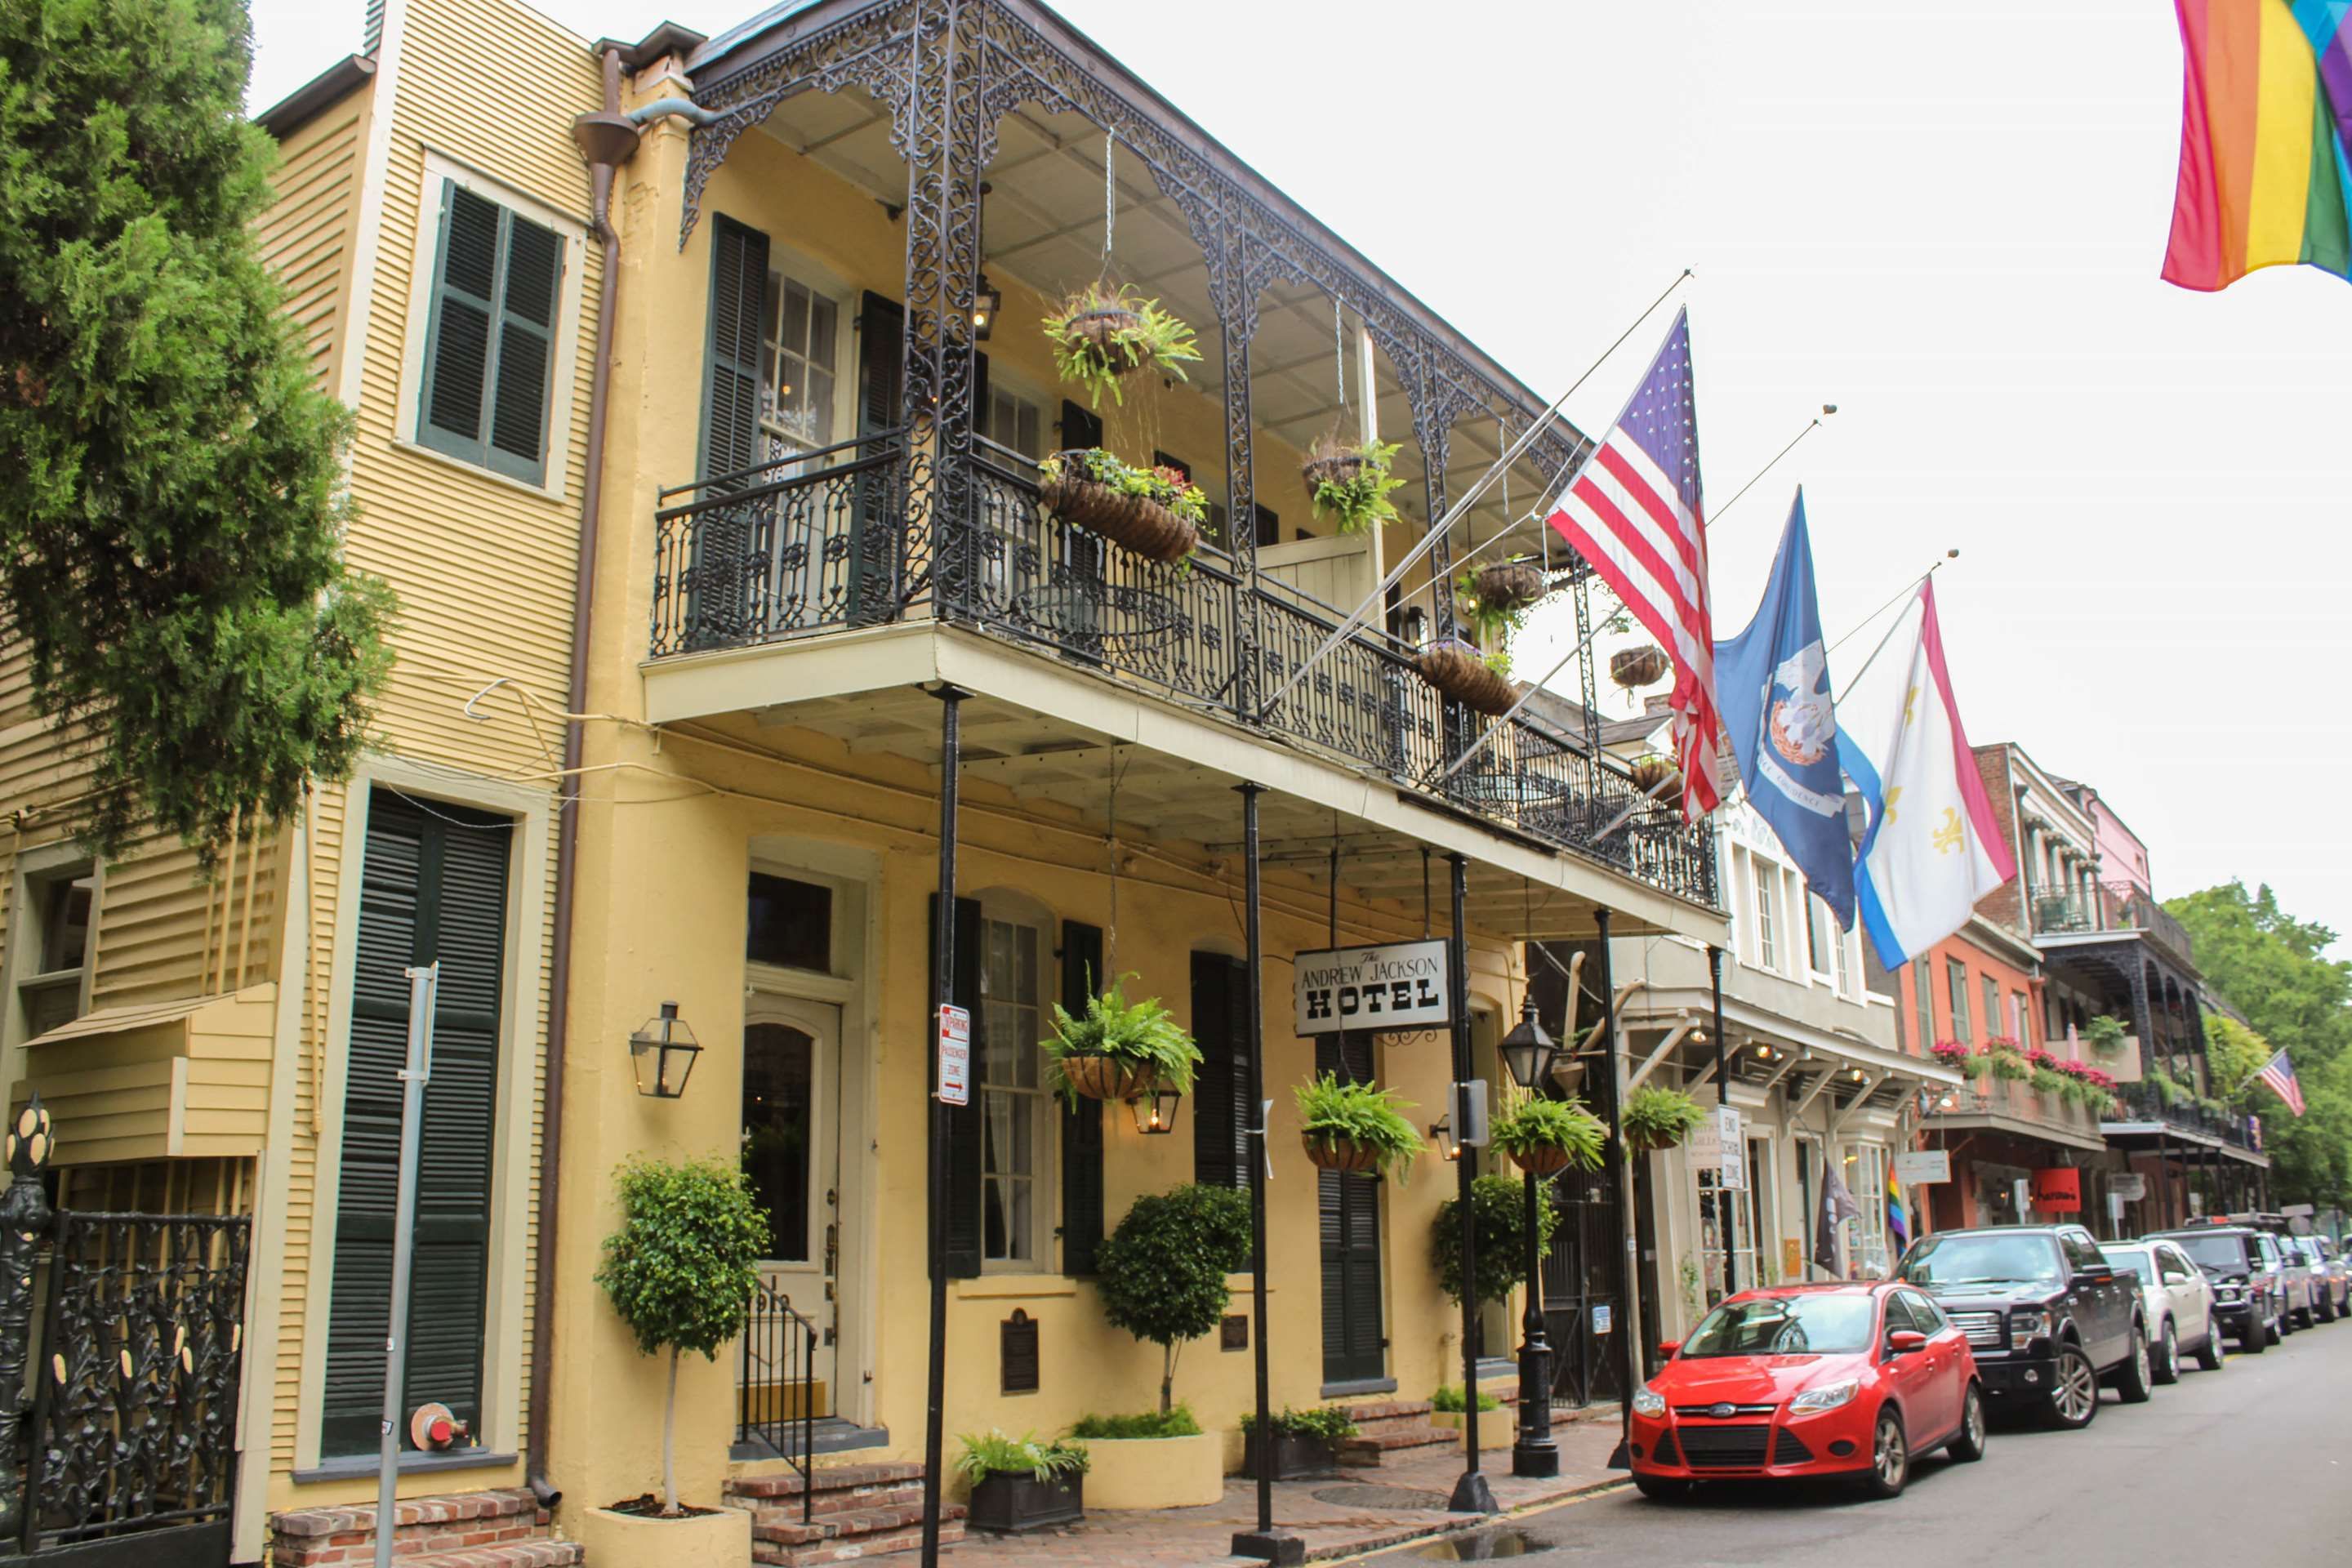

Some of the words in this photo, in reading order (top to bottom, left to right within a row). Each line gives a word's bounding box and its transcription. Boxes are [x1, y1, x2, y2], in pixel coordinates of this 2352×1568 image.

[1361, 951, 1380, 964] The
[1302, 964, 1363, 989] ANDREW
[1370, 956, 1438, 982] JACKSON
[1307, 978, 1439, 1019] HOTEL
[941, 1045, 967, 1060] PASSENGER
